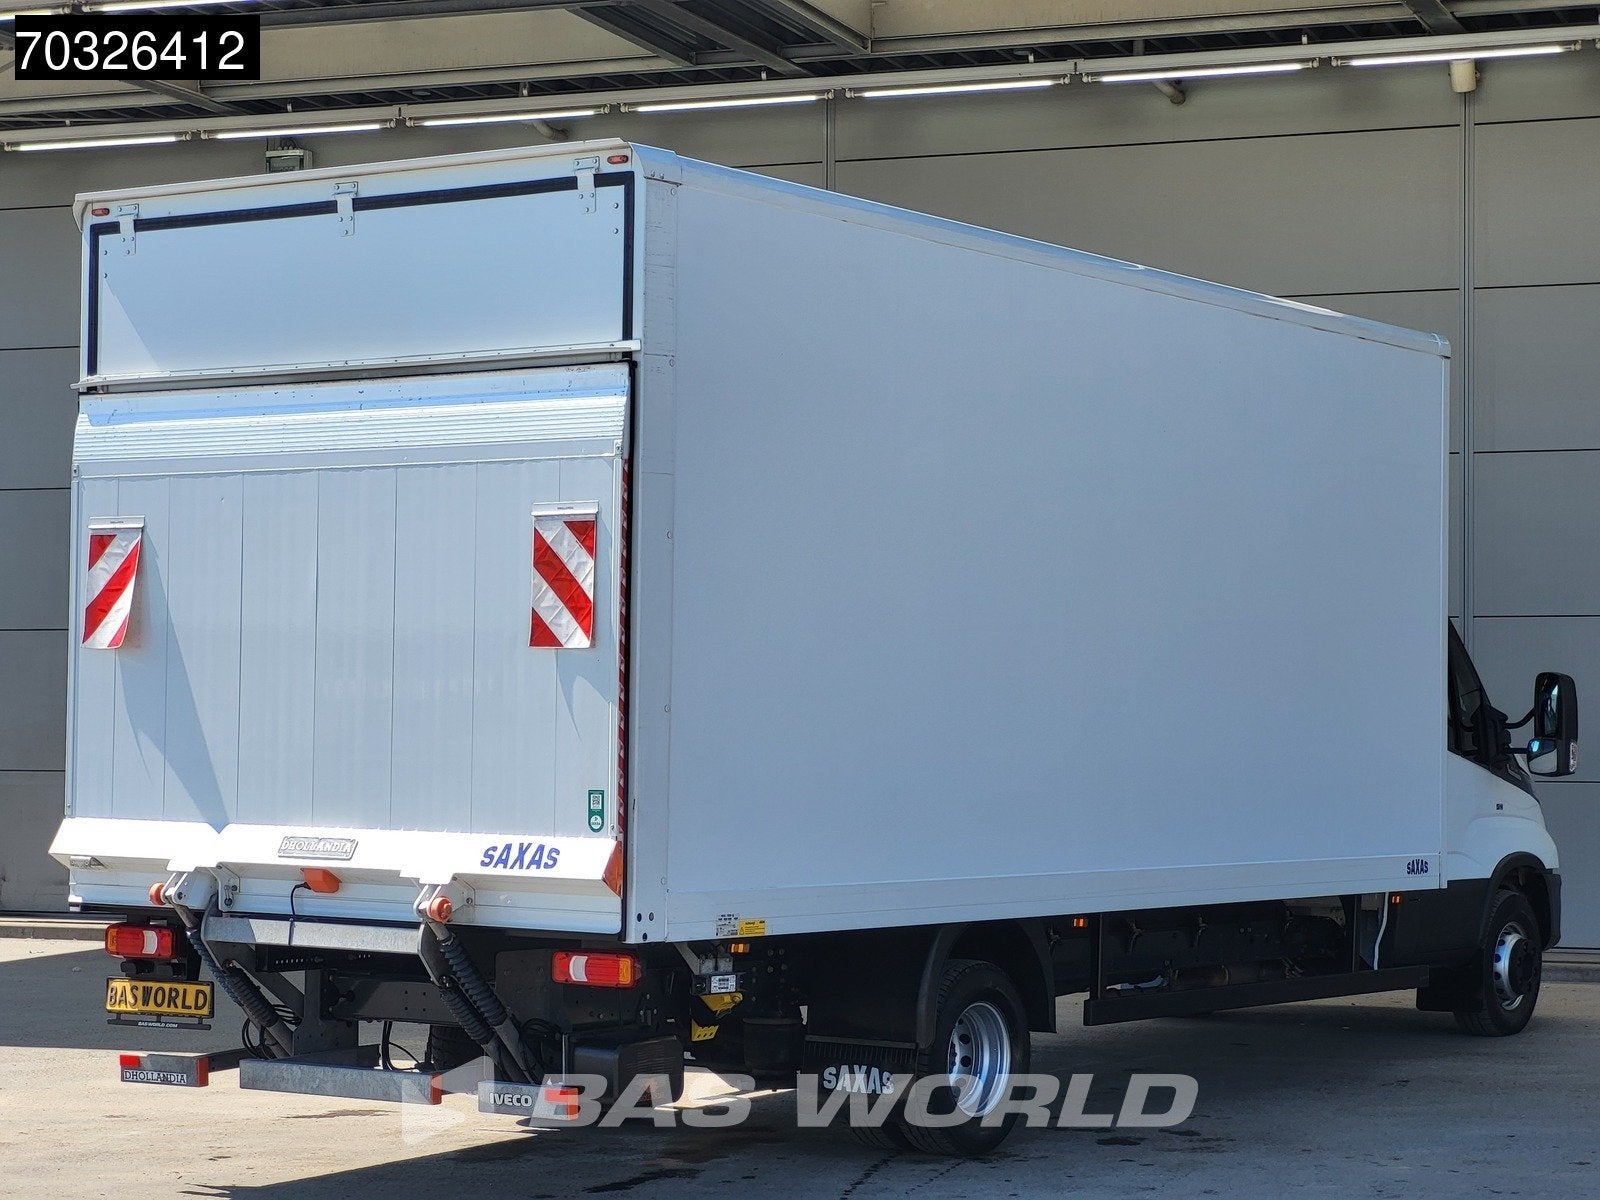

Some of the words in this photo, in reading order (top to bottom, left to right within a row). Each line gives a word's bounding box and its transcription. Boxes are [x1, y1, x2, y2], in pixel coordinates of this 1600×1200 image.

[480, 843, 561, 870] SAXAS
[1406, 859, 1429, 875] SAXAS
[125, 1071, 186, 1084] DHOLLANDIA
[823, 1064, 895, 1095] SAXAS
[489, 1092, 533, 1107] IVECO
